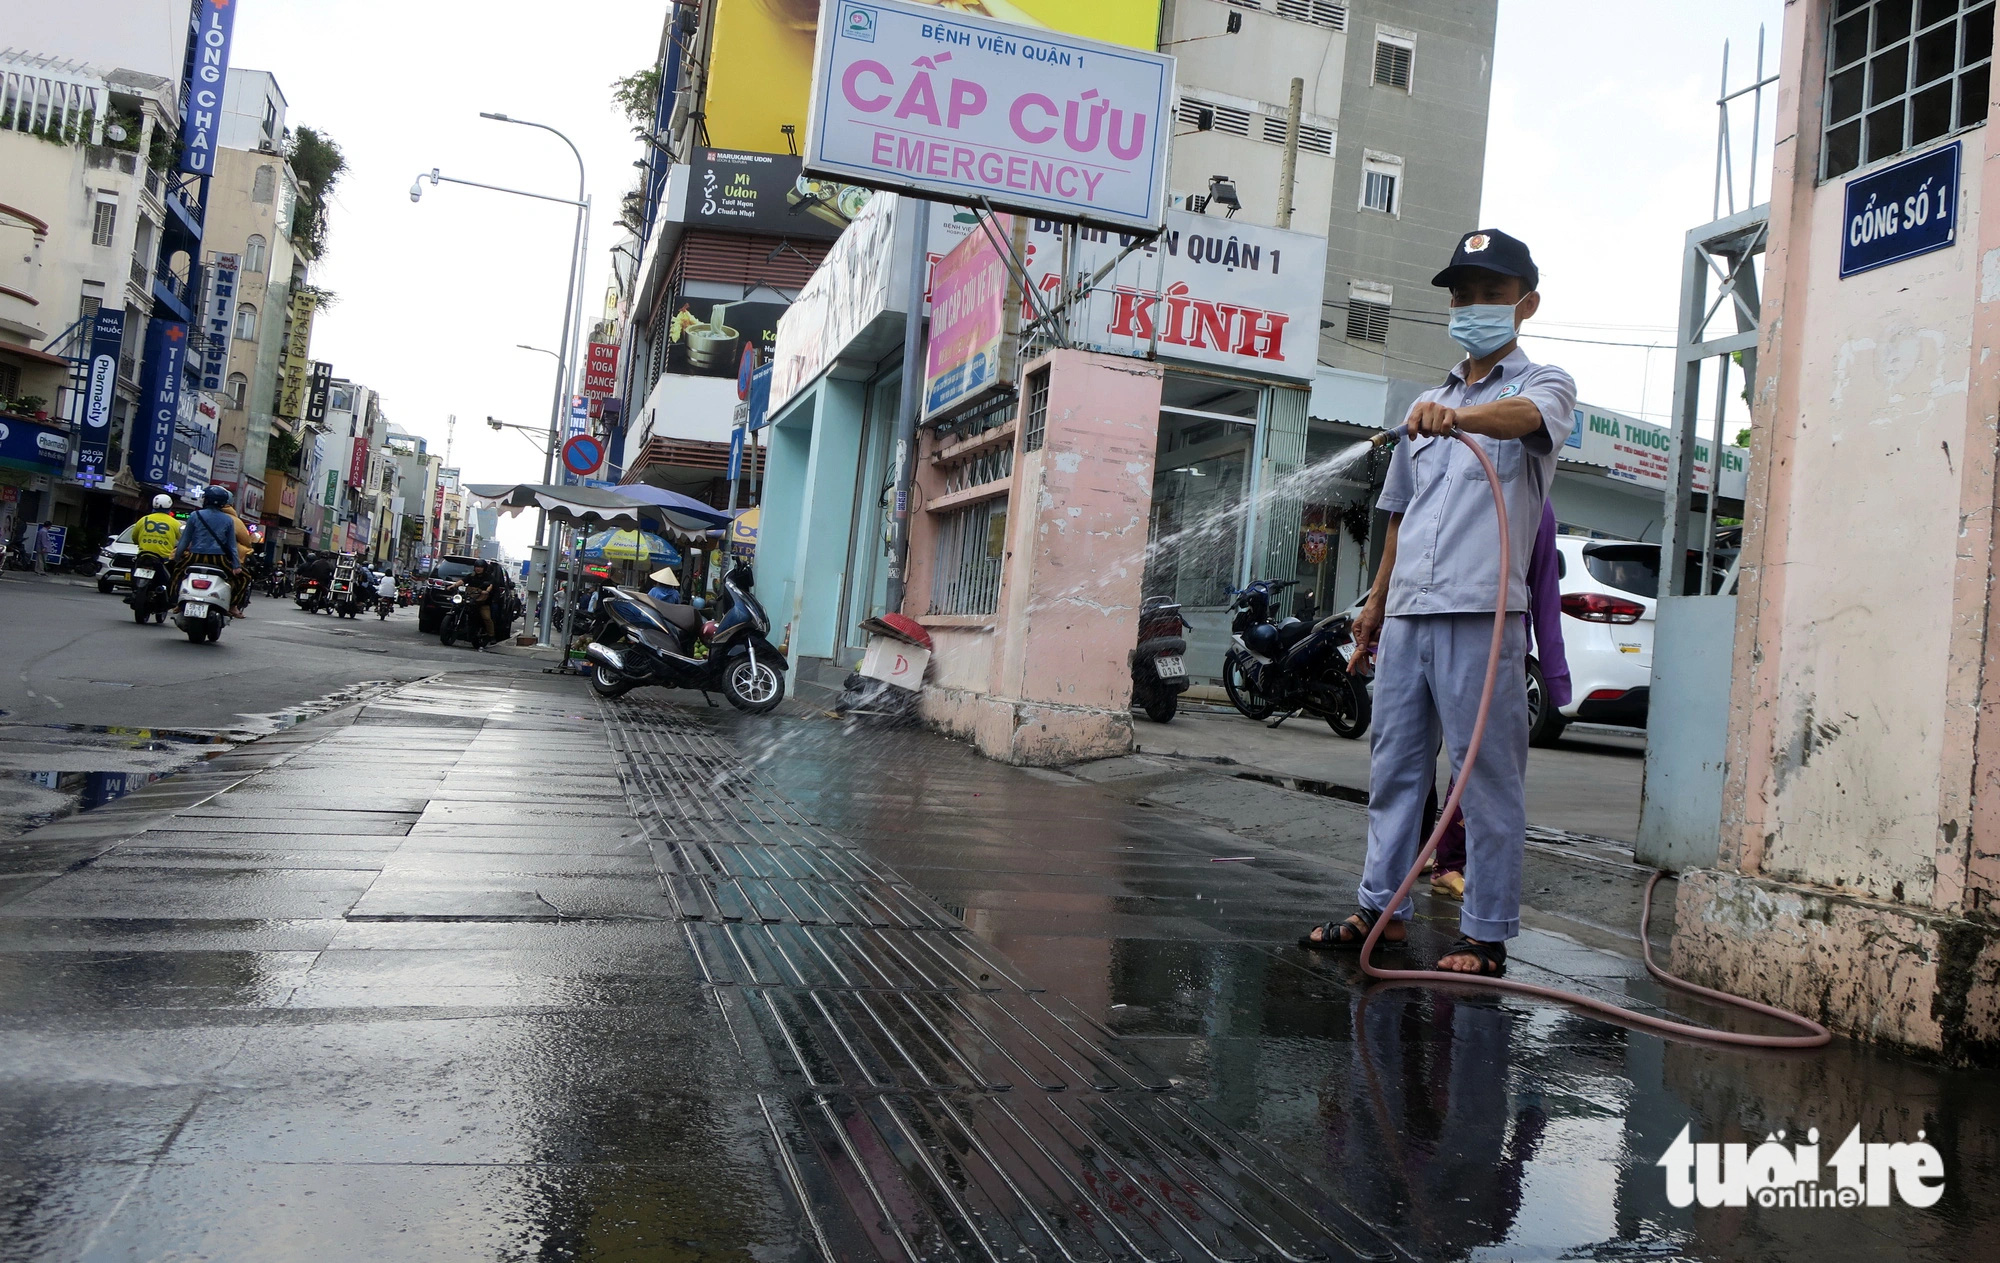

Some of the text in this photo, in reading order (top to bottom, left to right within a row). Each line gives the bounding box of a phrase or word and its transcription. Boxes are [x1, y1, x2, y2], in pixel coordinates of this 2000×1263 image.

[921, 24, 1085, 69] BỆNH VIỆN QUẬN 1
[190, 12, 225, 170] LONG CHÂU
[841, 51, 1147, 161] CẤP CỨU
[717, 152, 754, 162] MARUKAME
[871, 131, 1104, 201] EMERGENCY
[700, 169, 718, 216] うどん
[724, 185, 758, 199] Udon
[1850, 176, 1947, 247] CỔNG SỐ 1
[1187, 234, 1261, 272] QUẬN
[1270, 249, 1281, 275] 1
[97, 324, 122, 335] THUỐC
[1106, 281, 1290, 361] KÍNH
[591, 360, 614, 373] YOGA
[594, 346, 613, 358] GYM
[89, 358, 109, 422] Pharmacity
[587, 375, 614, 388] DANCE
[149, 347, 178, 480] TIÊM CHỦNG
[80, 455, 104, 464] 24/7
[1589, 414, 1621, 439] NHÀ
[1625, 424, 1671, 452] THUỐC
[1721, 452, 1743, 473] IỆN
[352, 446, 362, 486] AGRIBANK
[144, 517, 170, 535] be
